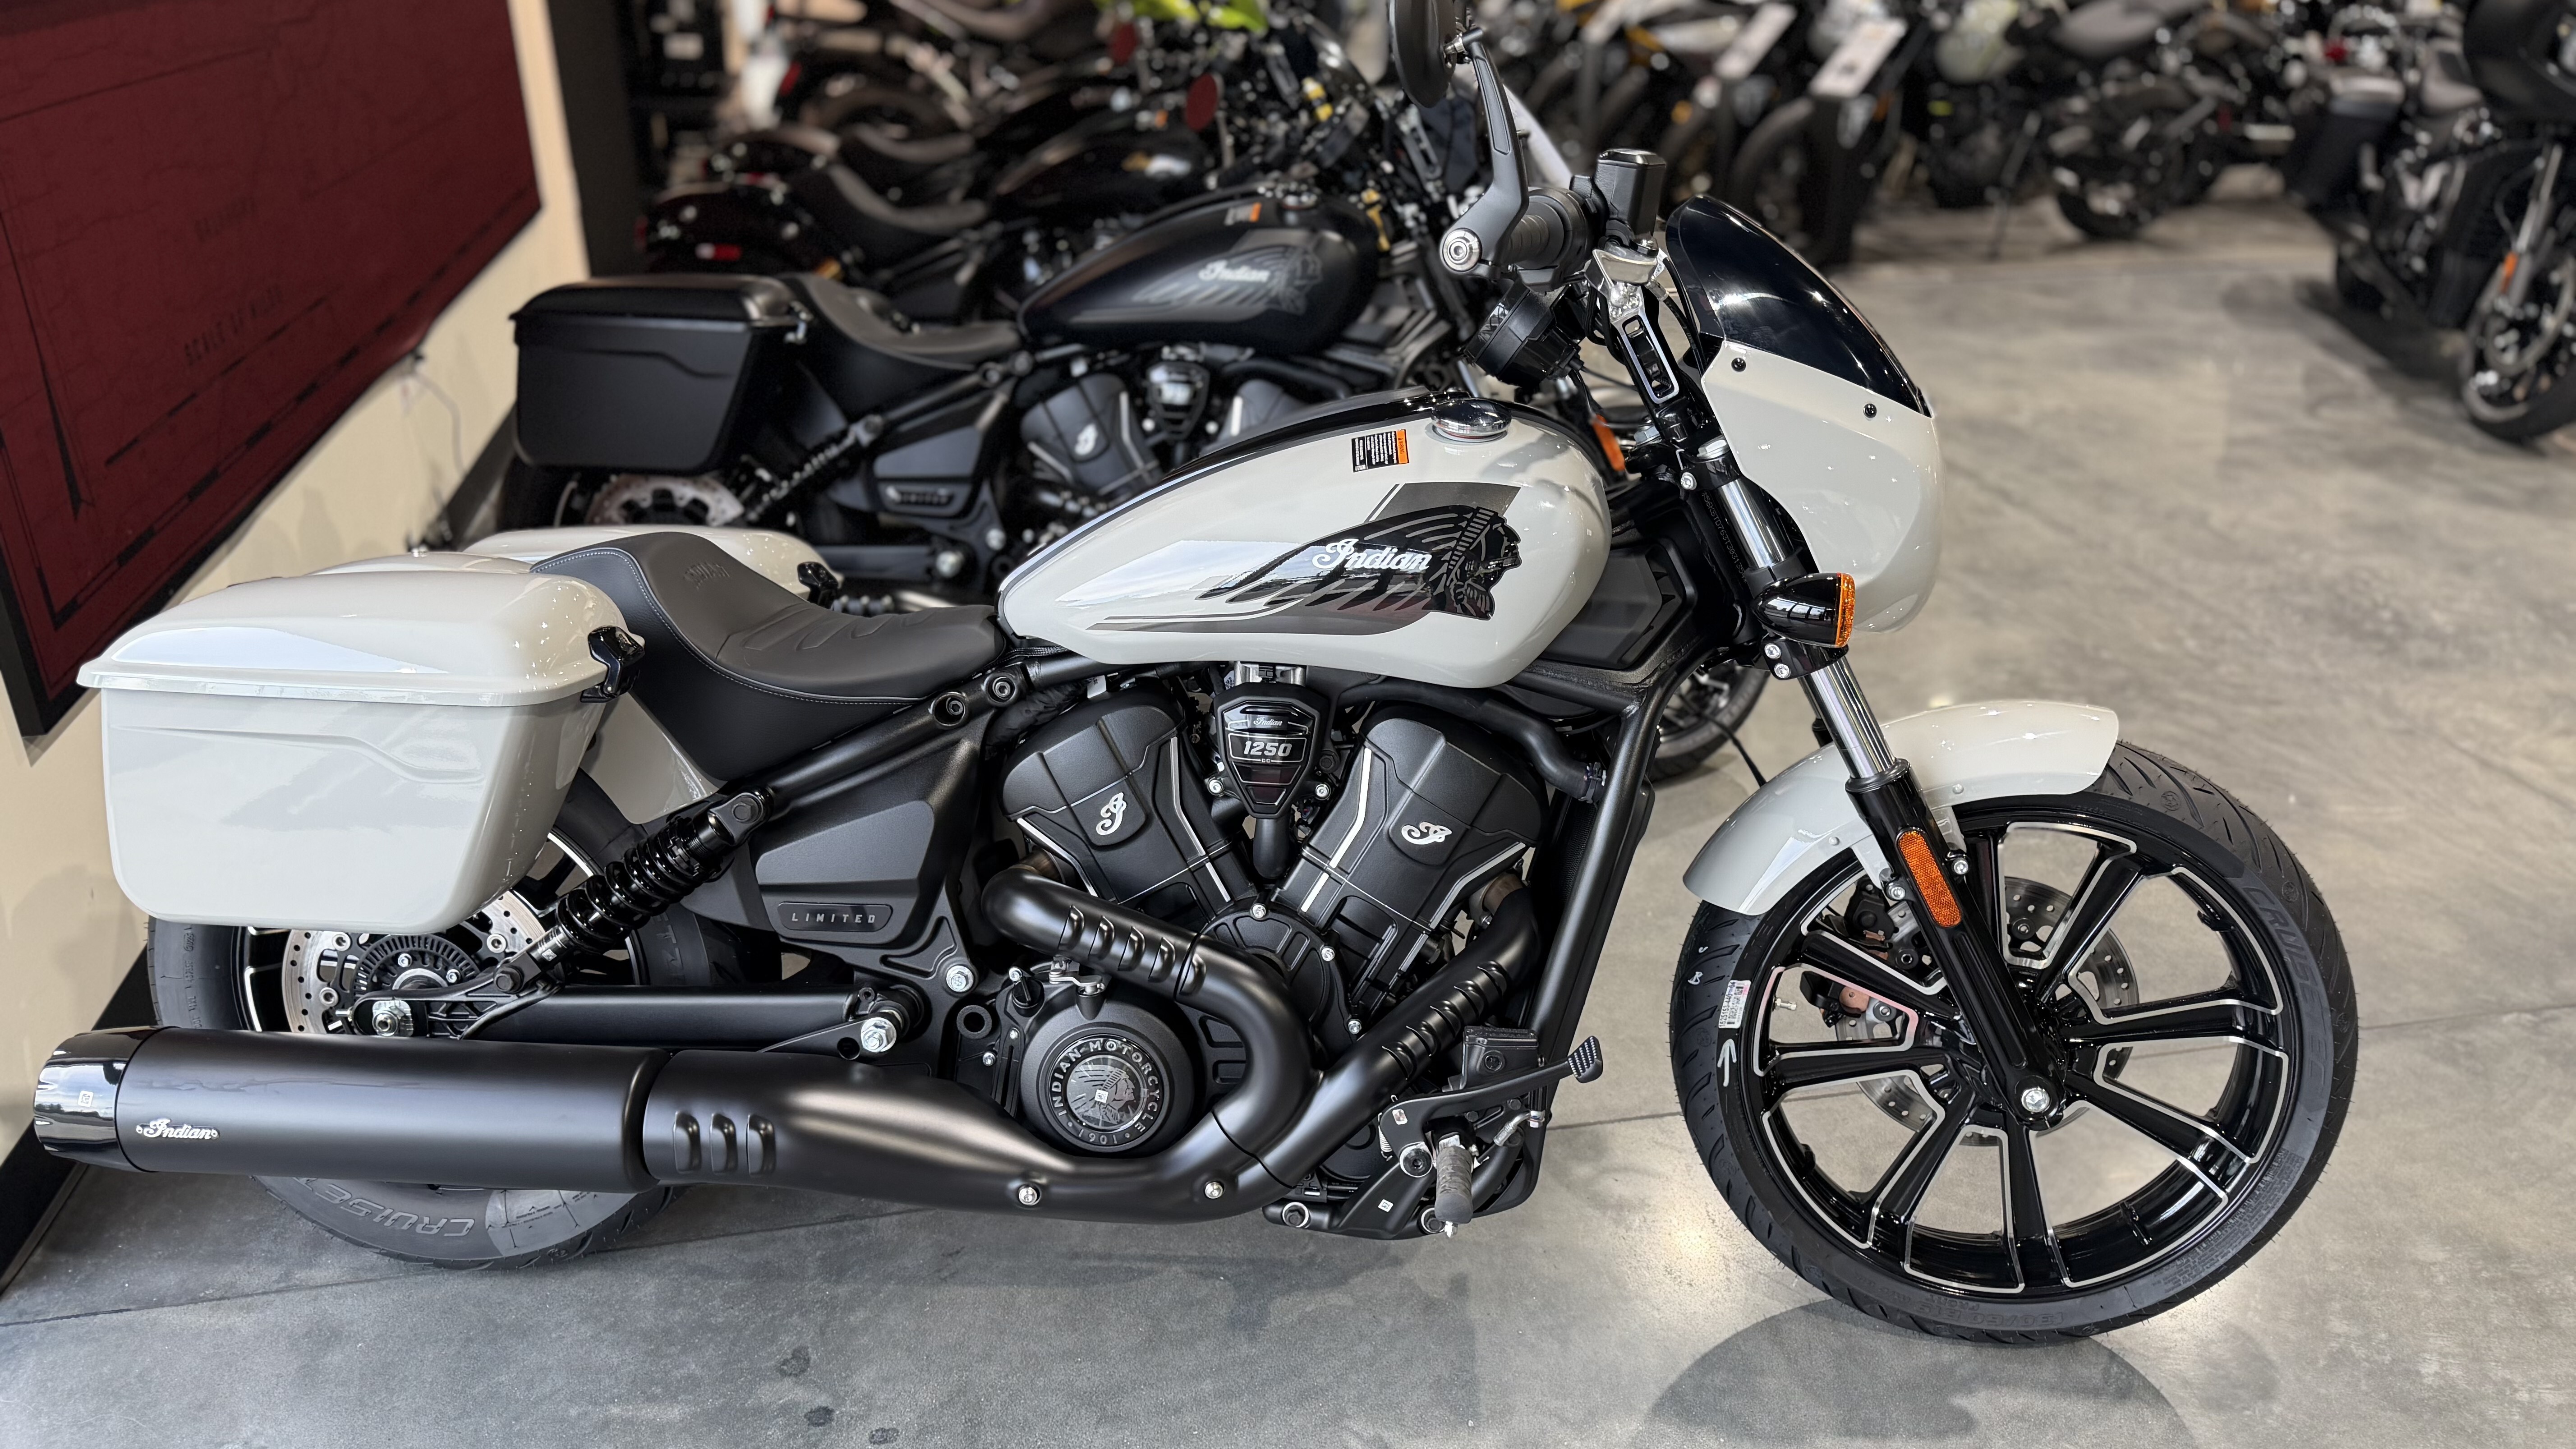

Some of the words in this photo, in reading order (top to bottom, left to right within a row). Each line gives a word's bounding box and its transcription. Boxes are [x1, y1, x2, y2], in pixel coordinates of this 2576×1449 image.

[1312, 538, 1433, 570] Indian
[1253, 717, 1283, 727] Indian
[1243, 741, 1293, 757] 1250
[792, 913, 875, 923] LIMITED
[1052, 1049, 1081, 1116] INDIAN
[1089, 1040, 1160, 1132] MOTORCYCLE
[143, 1118, 212, 1140] Indian
